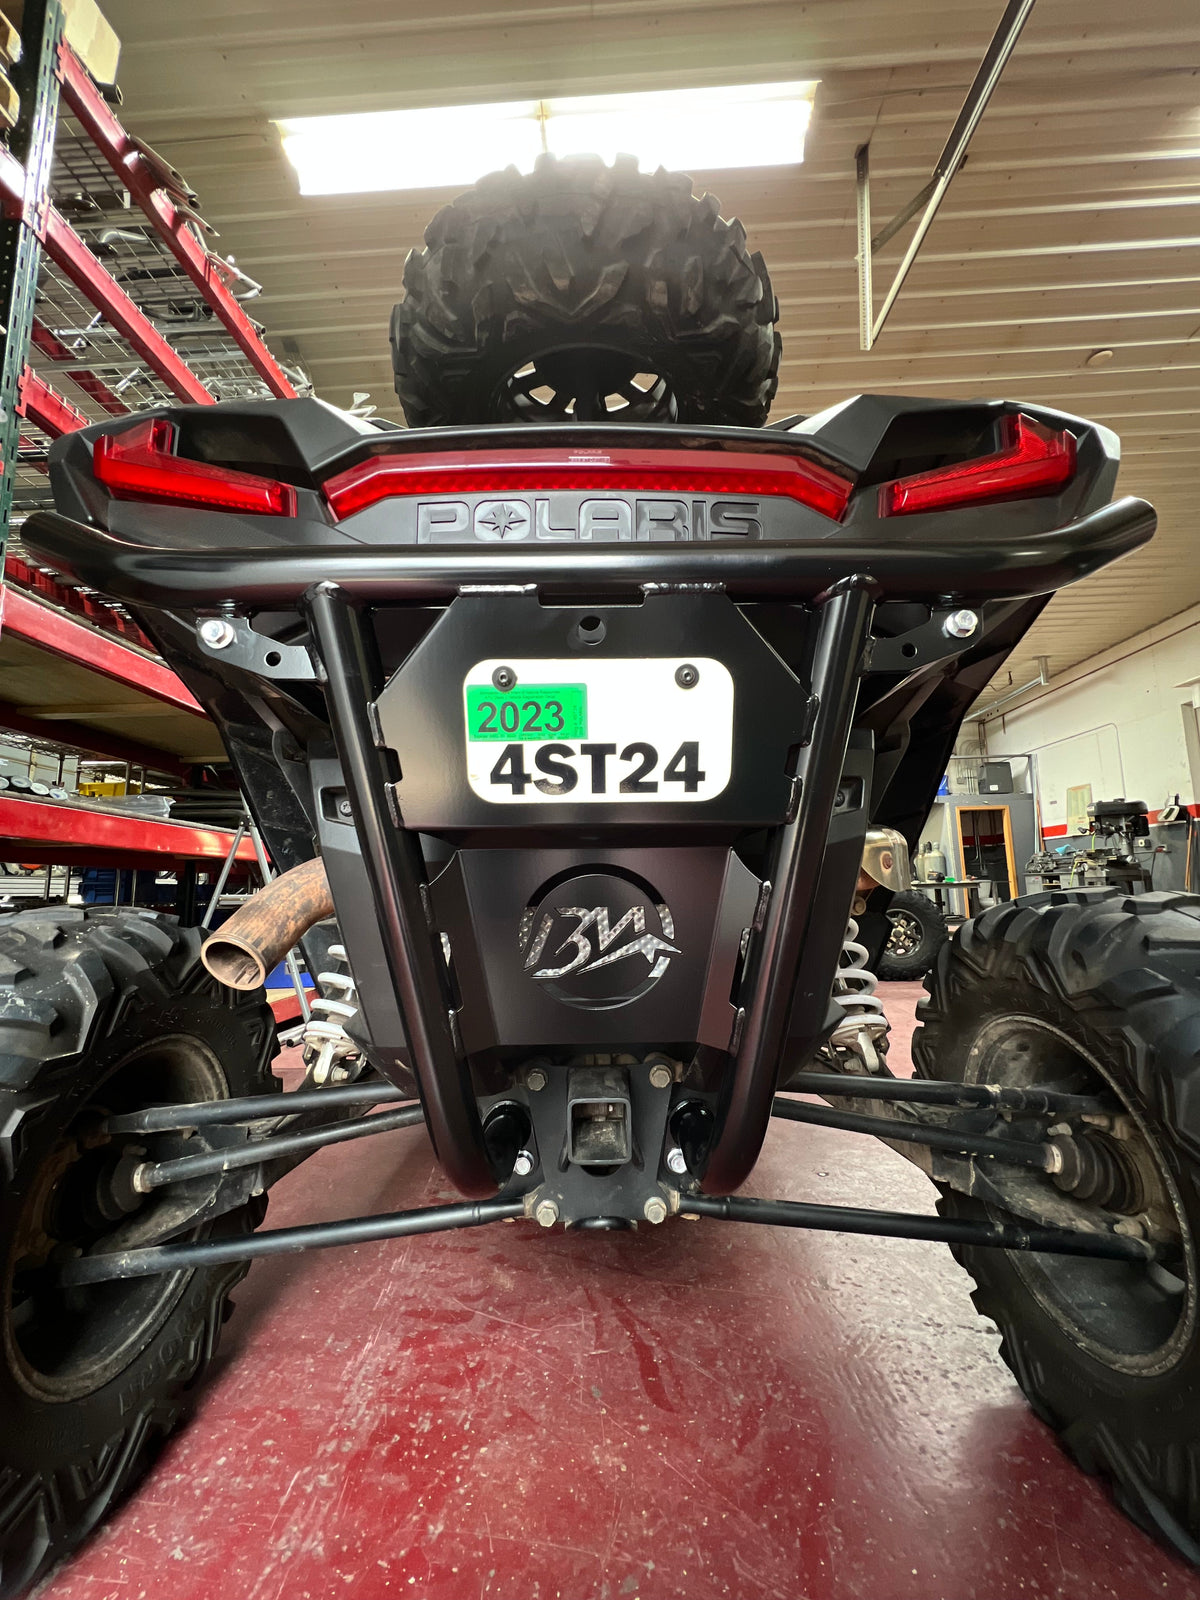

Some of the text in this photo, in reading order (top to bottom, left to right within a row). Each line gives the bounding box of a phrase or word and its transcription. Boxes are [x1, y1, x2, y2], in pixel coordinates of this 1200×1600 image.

[416, 499, 763, 543] POLARIS
[477, 701, 565, 733] 2023
[490, 741, 706, 796] 4ST24
